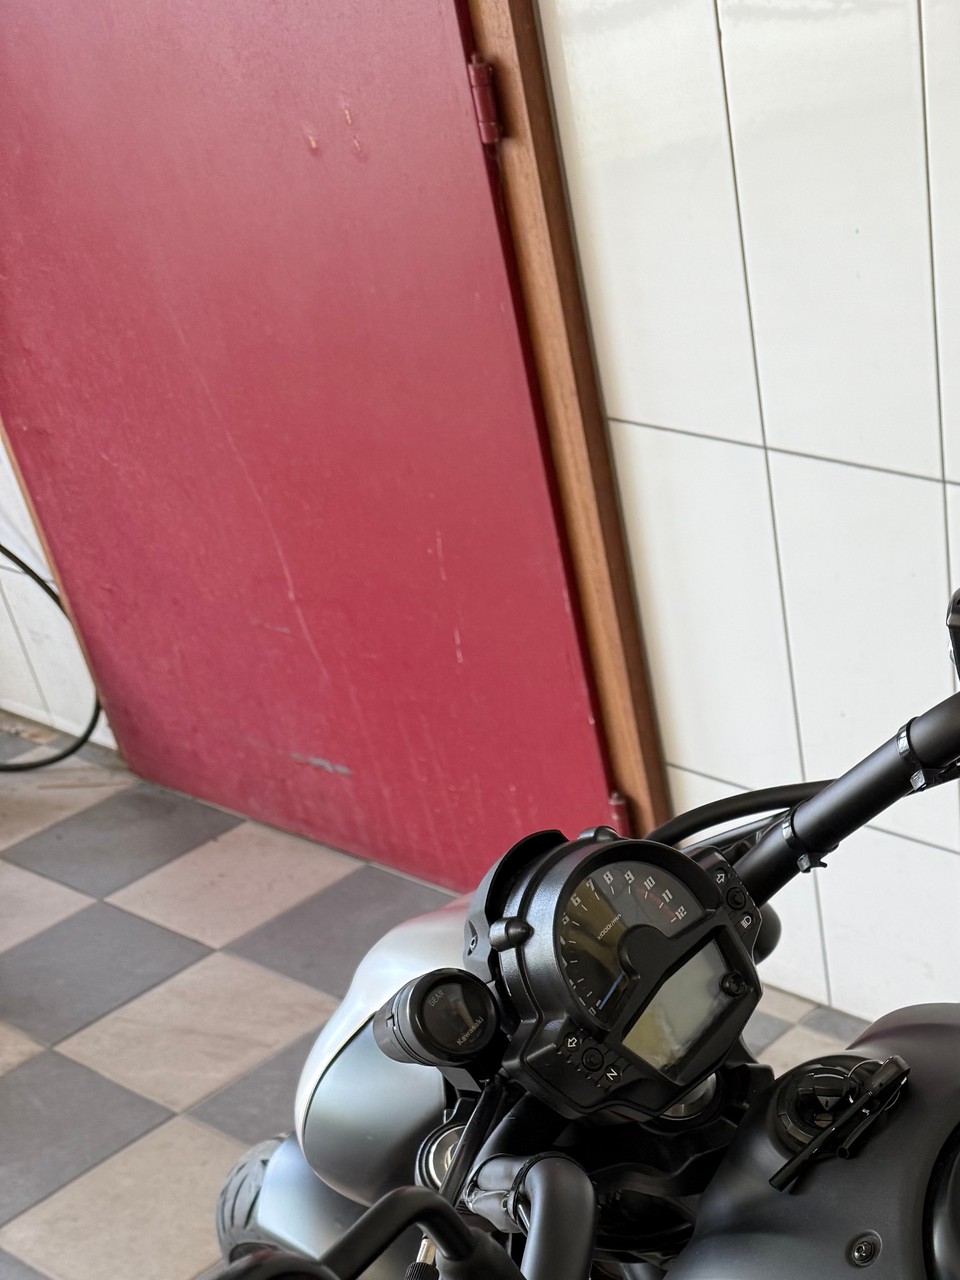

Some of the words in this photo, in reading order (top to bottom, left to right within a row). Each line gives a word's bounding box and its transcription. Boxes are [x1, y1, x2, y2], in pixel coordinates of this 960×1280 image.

[603, 871, 615, 885] 8
[624, 870, 635, 884] 9
[643, 876, 656, 890] 10
[586, 879, 596, 892] 7
[570, 893, 581, 907] 6
[662, 889, 673, 903] 11
[675, 905, 688, 920] 12
[606, 1068, 618, 1081] N
